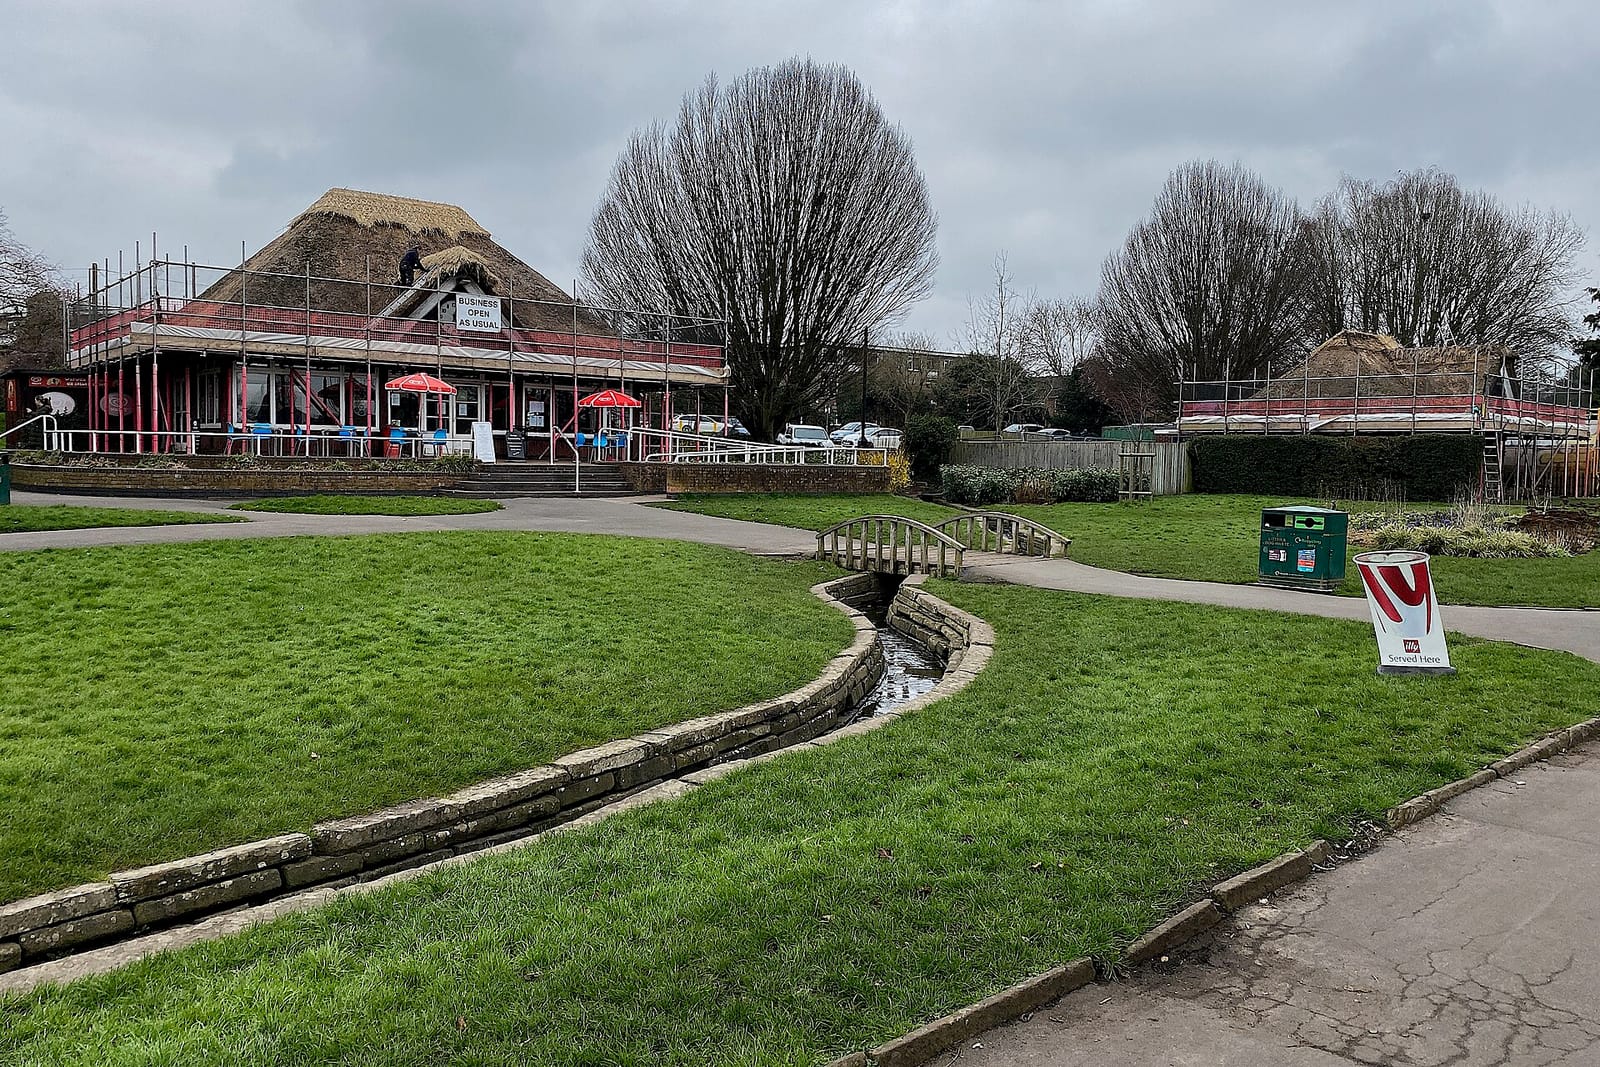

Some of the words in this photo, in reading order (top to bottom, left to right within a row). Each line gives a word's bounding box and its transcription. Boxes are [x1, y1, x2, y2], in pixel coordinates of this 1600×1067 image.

[458, 297, 498, 308] BUSINESS
[467, 308, 490, 318] OPEN
[459, 319, 470, 327] AS
[472, 320, 499, 329] USUAL
[1405, 641, 1419, 652] illy
[1388, 655, 1418, 663] Served
[1420, 655, 1441, 664] Here
